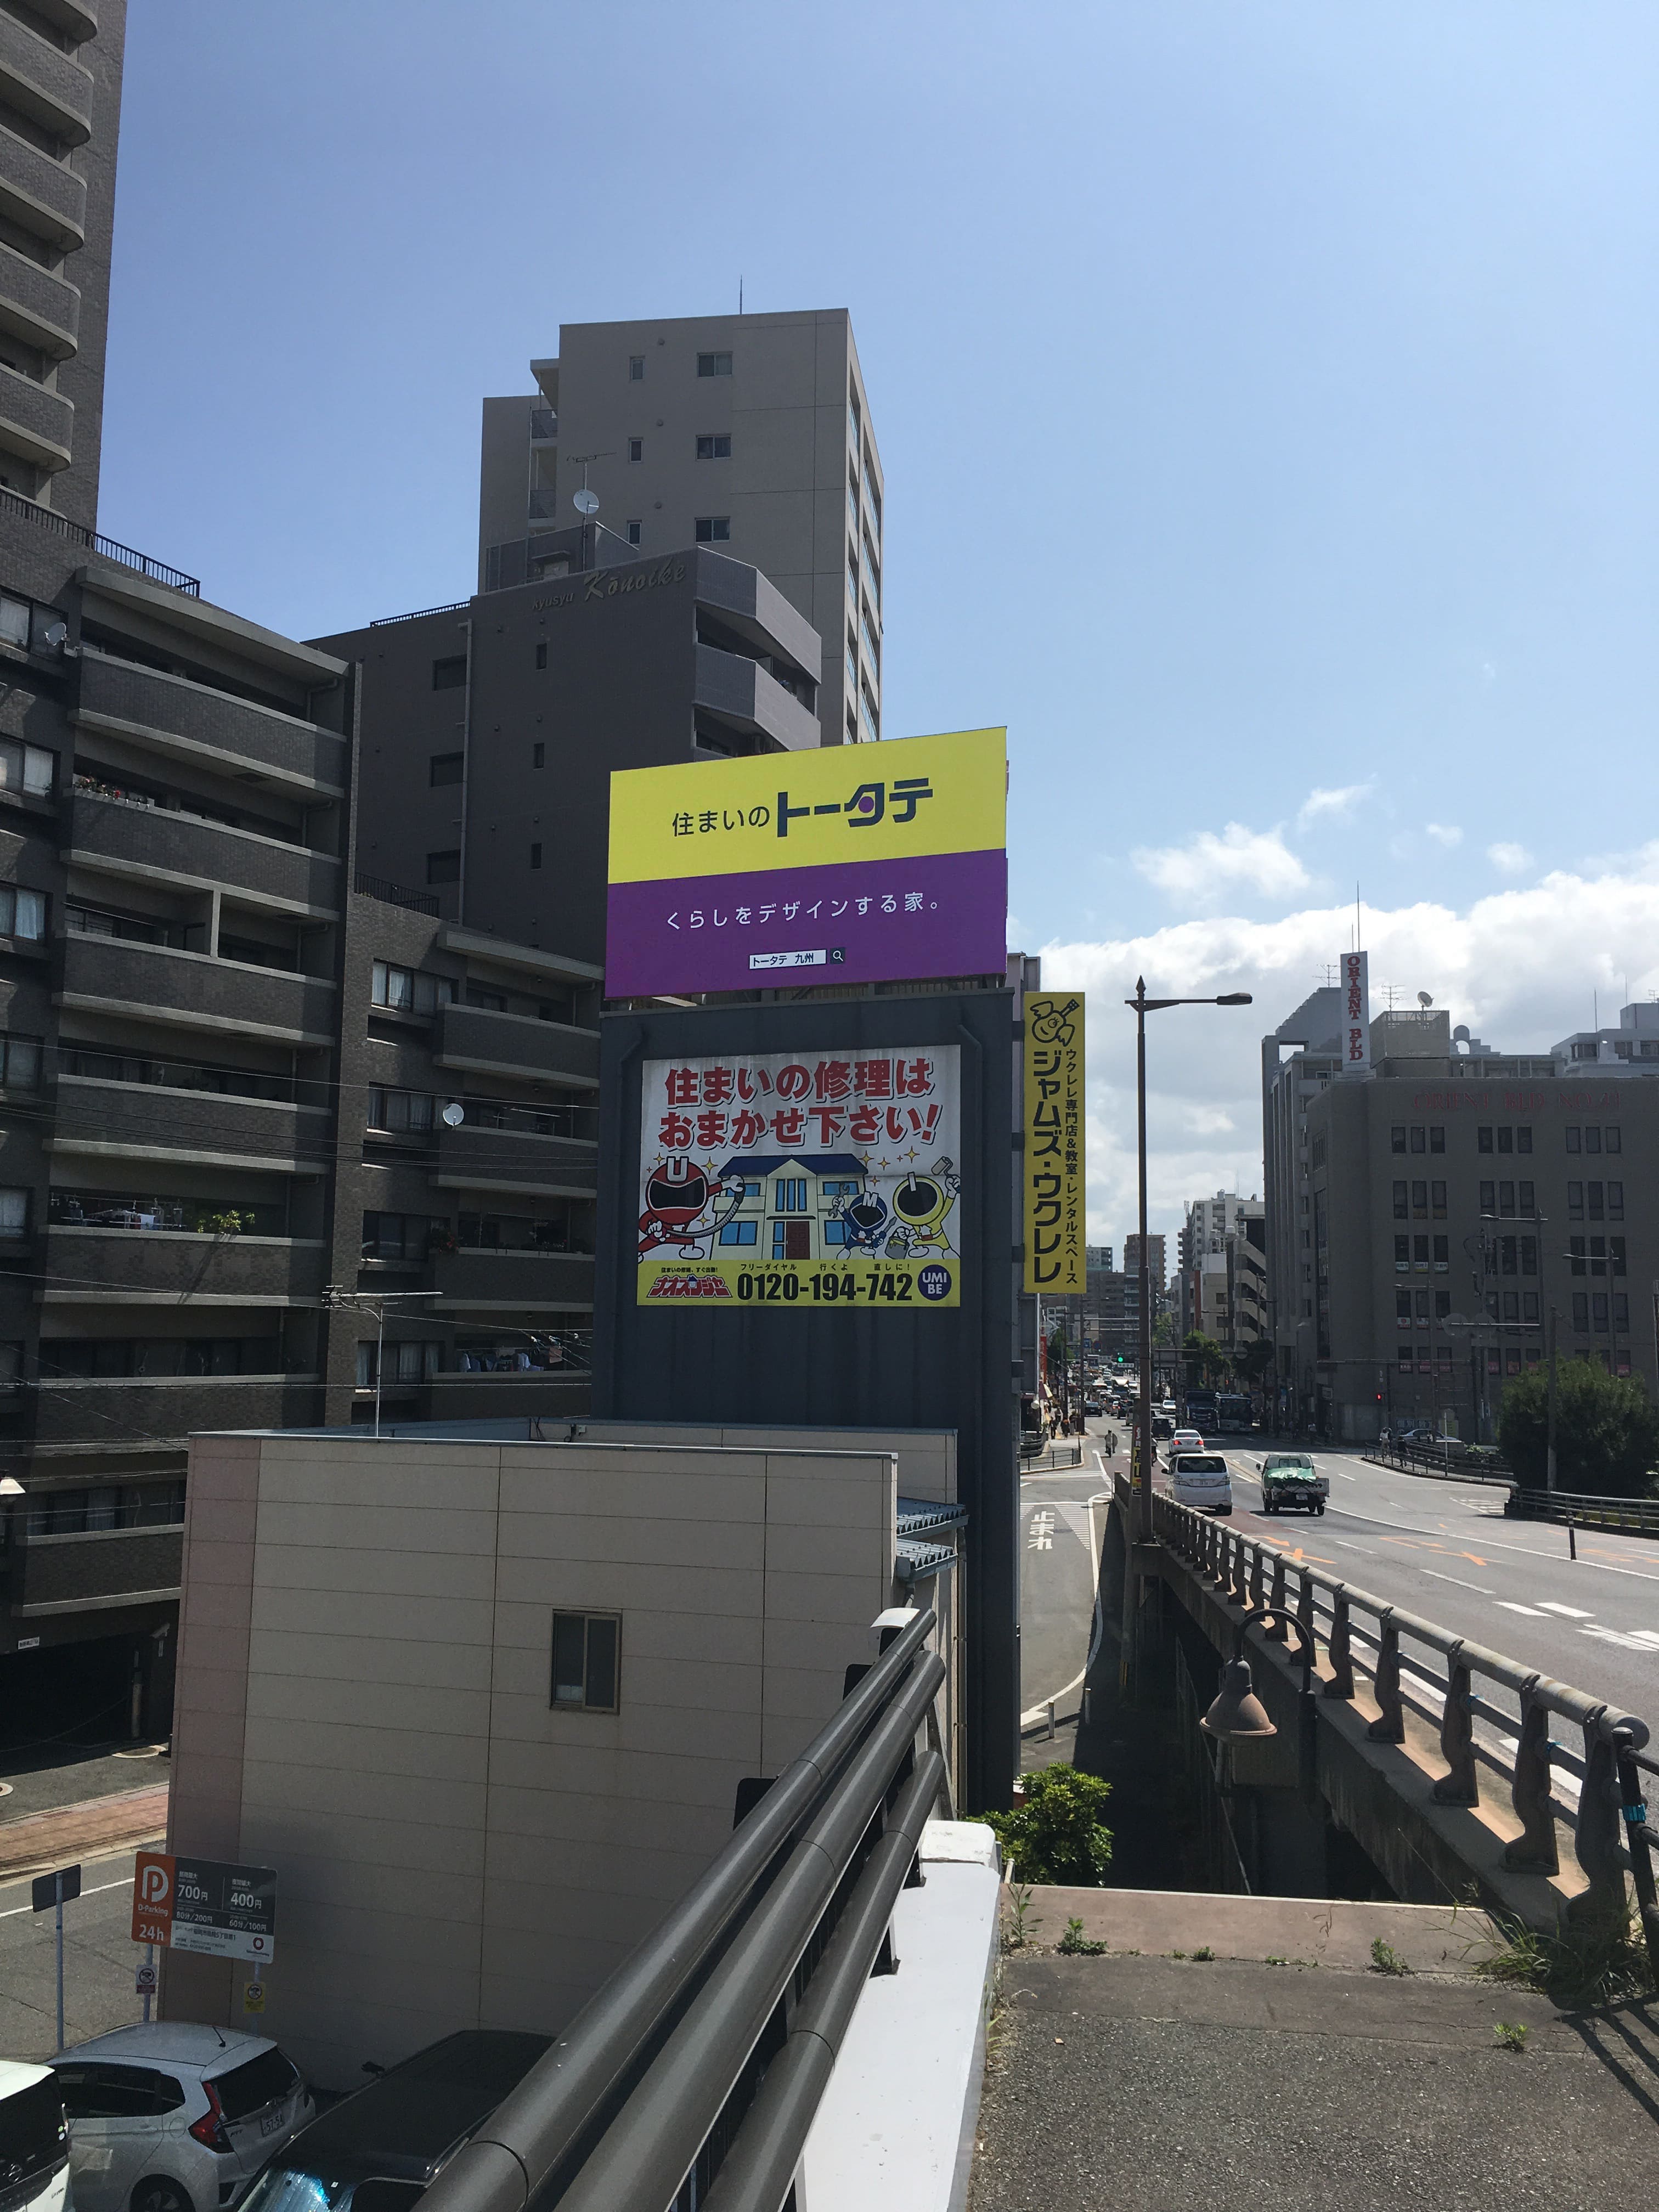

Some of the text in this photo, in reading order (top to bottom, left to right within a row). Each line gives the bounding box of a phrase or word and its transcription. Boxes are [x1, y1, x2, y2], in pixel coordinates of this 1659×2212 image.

[667, 891, 938, 930] くらしをデザインする家。
[752, 952, 815, 967] トータテ 九州
[1347, 956, 1363, 1060] ORIENT BLD
[665, 1058, 934, 1107] 住まいの修理は
[1413, 1092, 1489, 1110] ORIENT
[1504, 1092, 1545, 1111] BLD
[658, 1103, 943, 1148] おまかせ下さい!
[1033, 1049, 1062, 1284] ジャムズ・ウクレレ
[820, 1263, 848, 1271] 行くよ
[922, 1272, 947, 1283] UMI
[737, 1273, 913, 1301] 0120-194-742
[928, 1284, 943, 1295] BE
[1028, 1511, 1055, 1550] 止まれ
